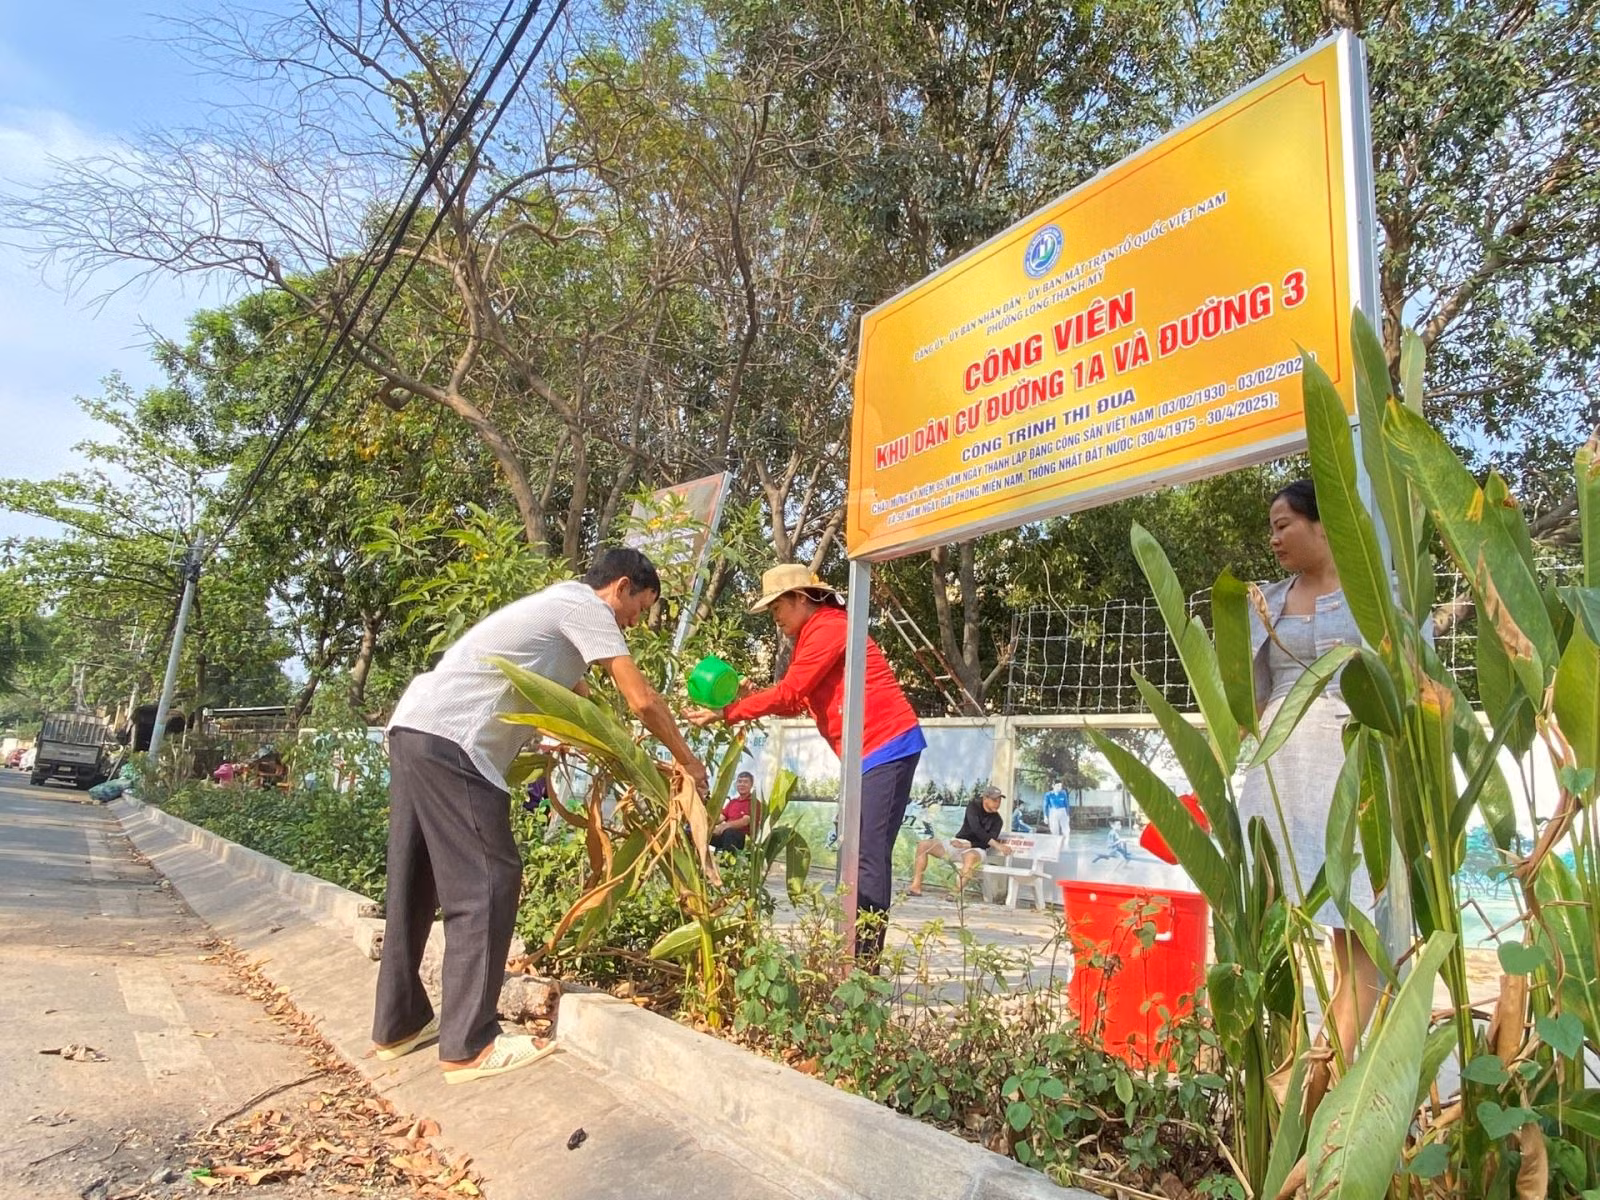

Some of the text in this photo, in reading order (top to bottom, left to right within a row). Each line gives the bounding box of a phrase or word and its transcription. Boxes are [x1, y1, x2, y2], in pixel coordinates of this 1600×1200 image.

[960, 321, 976, 336] BAN
[977, 308, 1001, 325] NHÂN
[1003, 297, 1021, 313] DÂN
[1042, 277, 1062, 293] BAN
[1117, 236, 1132, 255] TỔ
[1134, 220, 1166, 248] QUỐC
[1169, 208, 1194, 229] VIỆT
[1197, 192, 1227, 216] NAM
[986, 310, 1023, 336] PHƯỜNG
[1025, 299, 1050, 317] LONG
[876, 271, 1305, 470] KHU DÂN CƯ ĐƯỜNG 1A VÀ ĐƯỜNG 3
[964, 291, 1134, 393] CÔNG VIÊN
[906, 505, 921, 519] NĂM
[955, 486, 980, 502] PHÓNG
[981, 478, 1002, 494] MIỀN
[1028, 460, 1056, 481] THỐNG
[1058, 451, 1083, 473] NHẤT
[1085, 446, 1102, 463] ĐẤT
[1105, 435, 1133, 456] NƯỚC
[1137, 418, 1196, 448] (30/4/1975
[1207, 393, 1280, 425] 30/4/2025);
[945, 472, 961, 488] NĂM
[962, 465, 982, 482] NGÀY
[984, 456, 1011, 475] THÀNH
[1012, 449, 1027, 468] LẬP
[1029, 441, 1054, 461] ĐẢNG
[1055, 433, 1081, 450] CỘNG
[1083, 423, 1104, 442] SẢN
[1106, 415, 1127, 435] VIỆT
[1129, 408, 1154, 426] NAM
[1157, 383, 1226, 418] (03/02/1930
[1238, 353, 1316, 391] 03/02/202)
[962, 389, 1136, 462] CÔNG TRÌNH THI ĐUA
